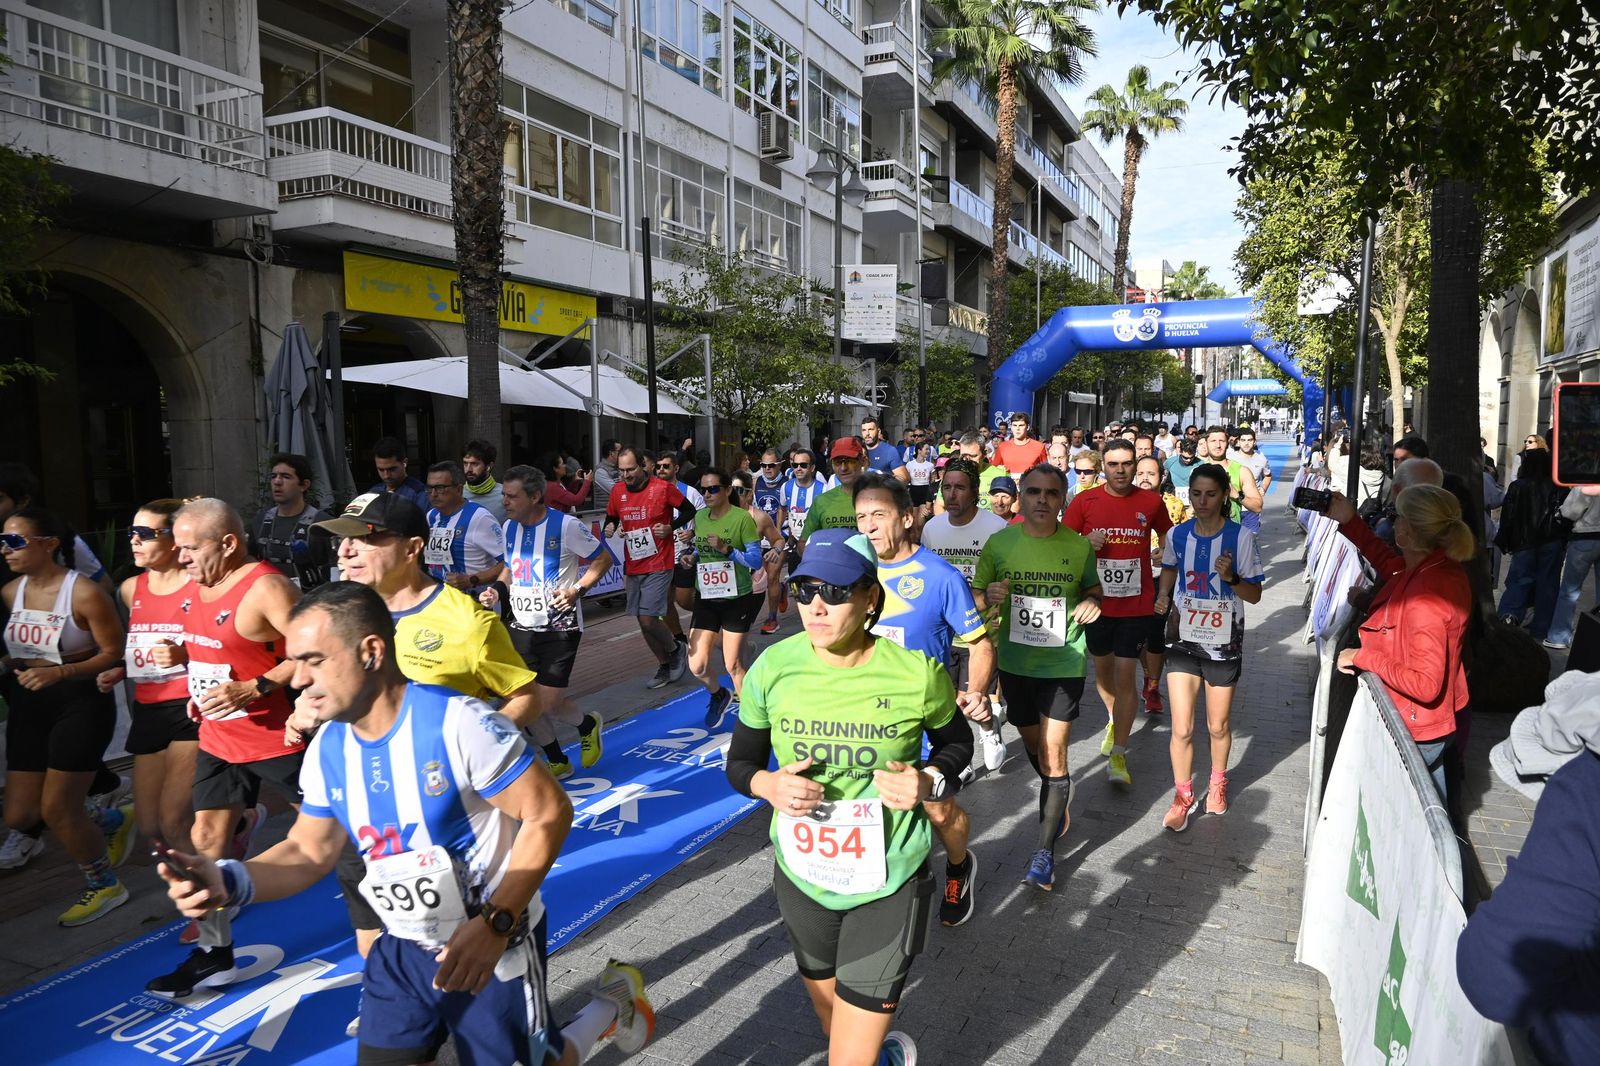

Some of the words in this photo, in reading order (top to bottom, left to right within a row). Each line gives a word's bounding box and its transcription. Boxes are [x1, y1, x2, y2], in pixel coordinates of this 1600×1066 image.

[1164, 322, 1208, 330] PROVINCIAL
[792, 519, 805, 528] 74
[826, 516, 857, 524] C.D.RUN
[628, 536, 649, 550] 754
[703, 571, 728, 586] 950
[1104, 569, 1134, 584] 897
[1014, 583, 1062, 597] sano
[511, 598, 543, 612] 1025
[1019, 608, 1054, 628] 951
[1188, 610, 1222, 628] 778
[8, 623, 58, 646] 1007
[130, 624, 150, 632] SAN
[134, 648, 156, 668] 84
[793, 742, 878, 768] sano
[793, 822, 866, 859] 954
[372, 876, 442, 912] 596
